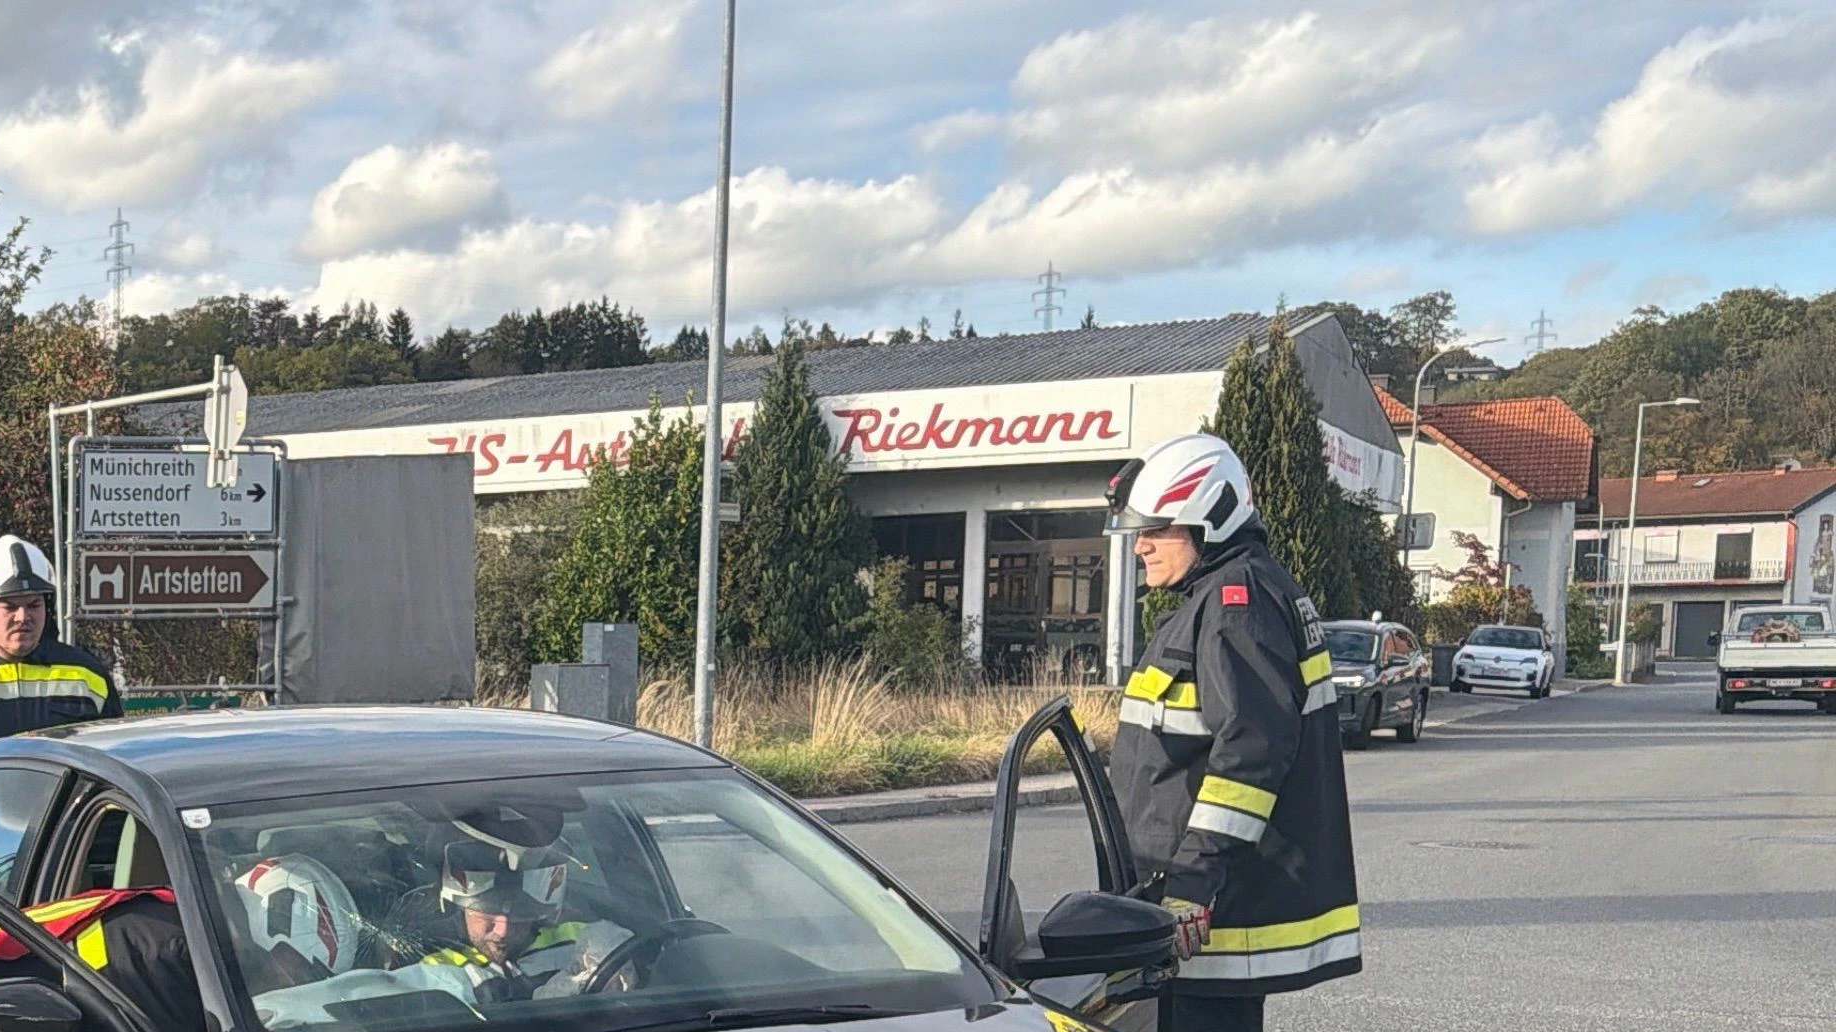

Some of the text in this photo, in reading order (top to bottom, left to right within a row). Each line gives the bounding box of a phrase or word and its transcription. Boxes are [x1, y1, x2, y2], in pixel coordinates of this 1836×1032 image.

[832, 403, 1122, 454] Riekmann
[90, 457, 195, 477] Münichreith
[90, 483, 191, 501] Nussendorf
[90, 508, 181, 527] Artstetten
[138, 564, 242, 595] Artstetten
